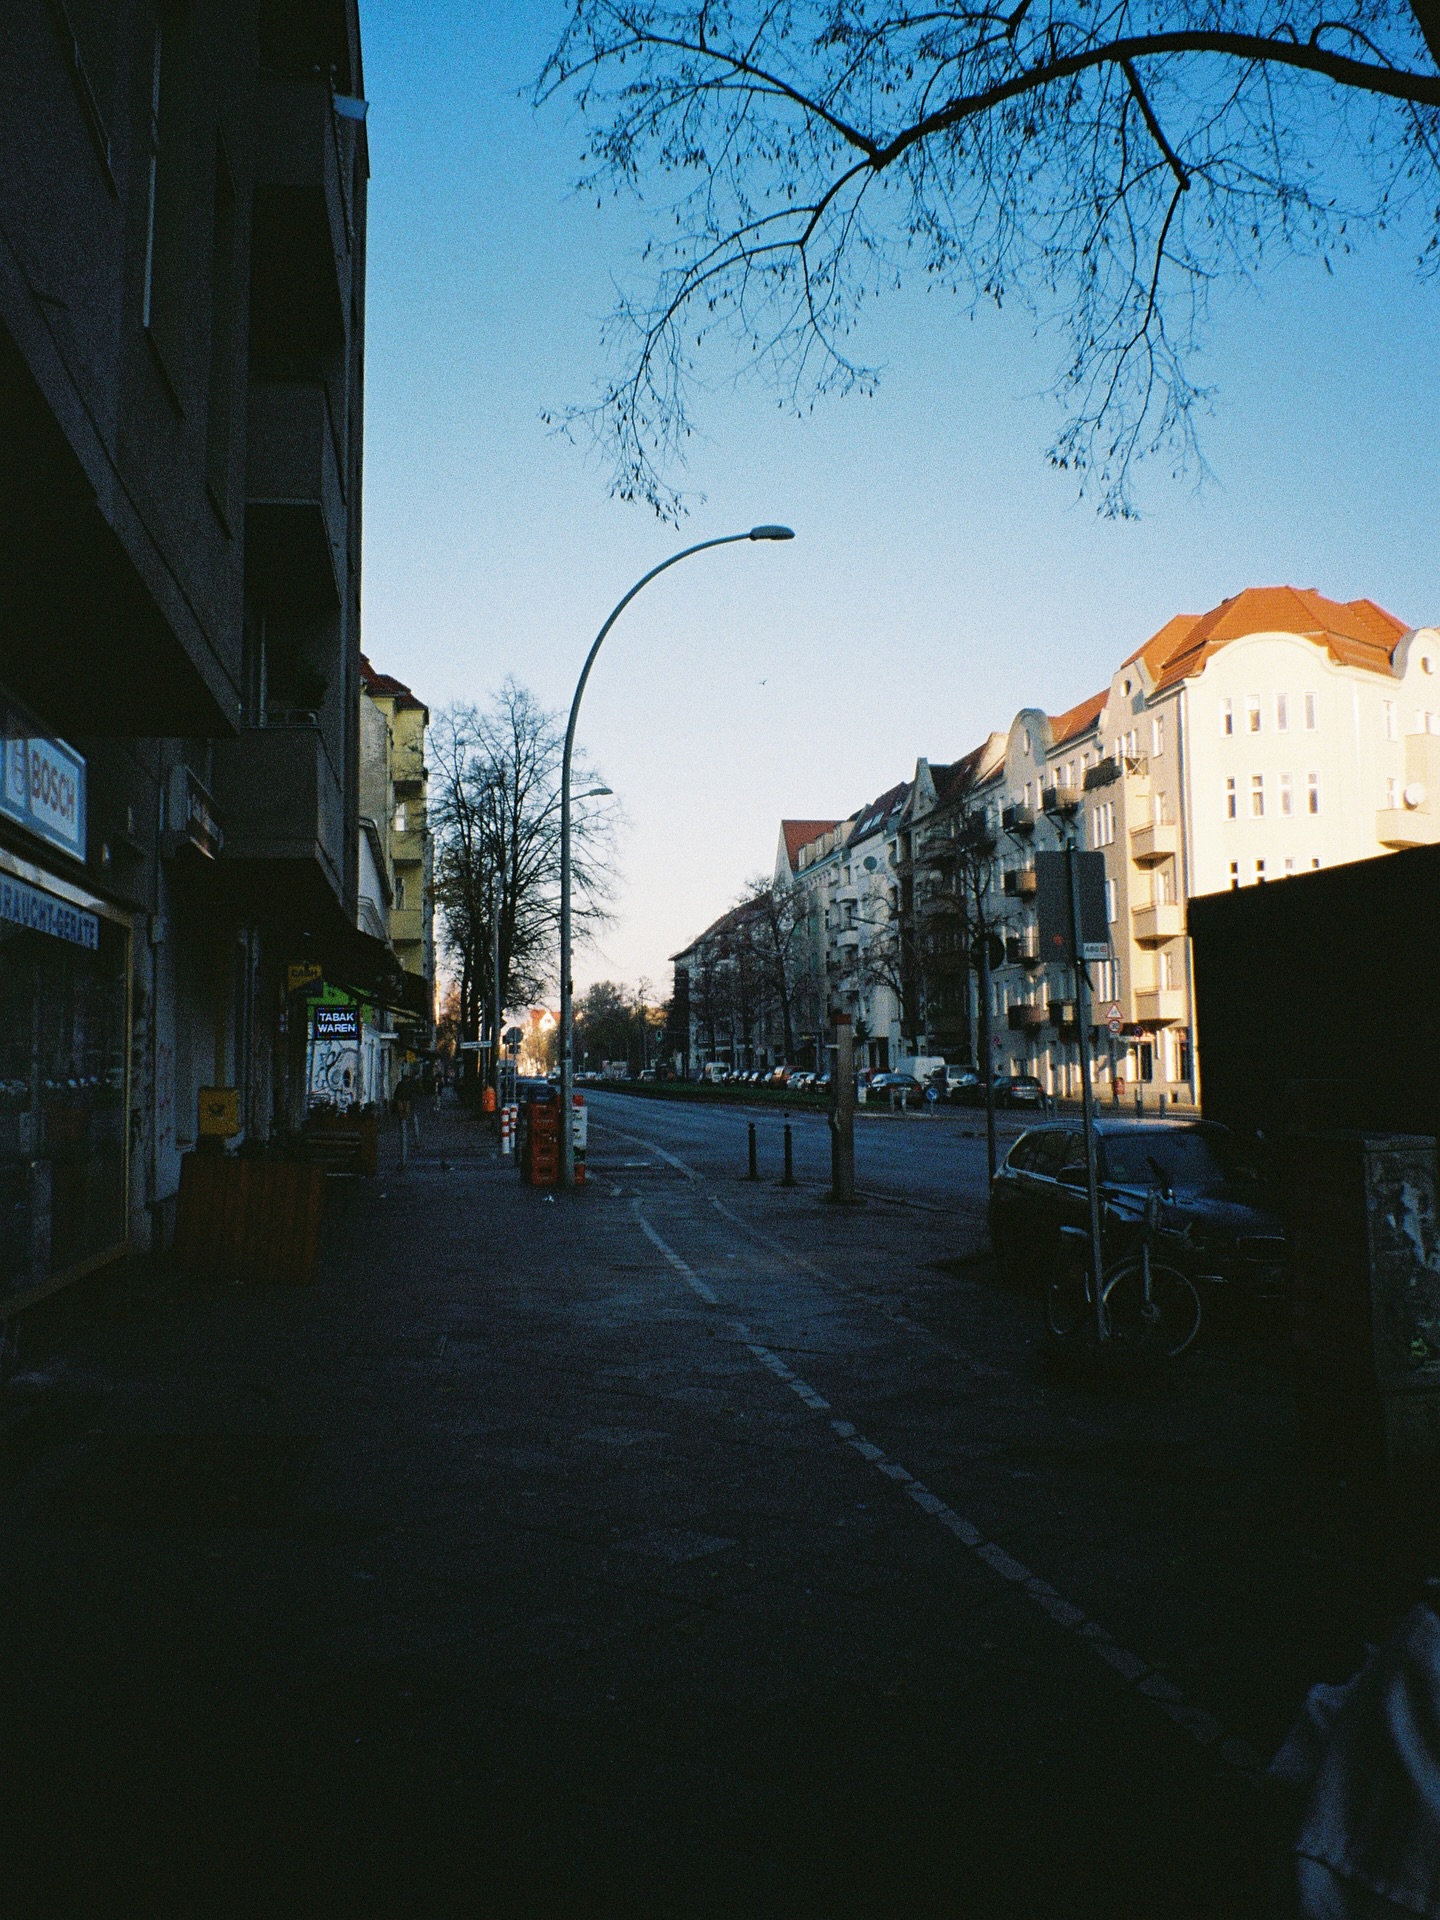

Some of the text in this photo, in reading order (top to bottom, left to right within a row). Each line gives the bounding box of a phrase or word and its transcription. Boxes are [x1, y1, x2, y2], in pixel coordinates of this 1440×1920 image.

[31, 749, 75, 824] BOSCH
[0, 882, 95, 949] RAUCHT-GERÄTE
[317, 1023, 356, 1033] WAREN
[319, 1012, 355, 1022] TABAK
